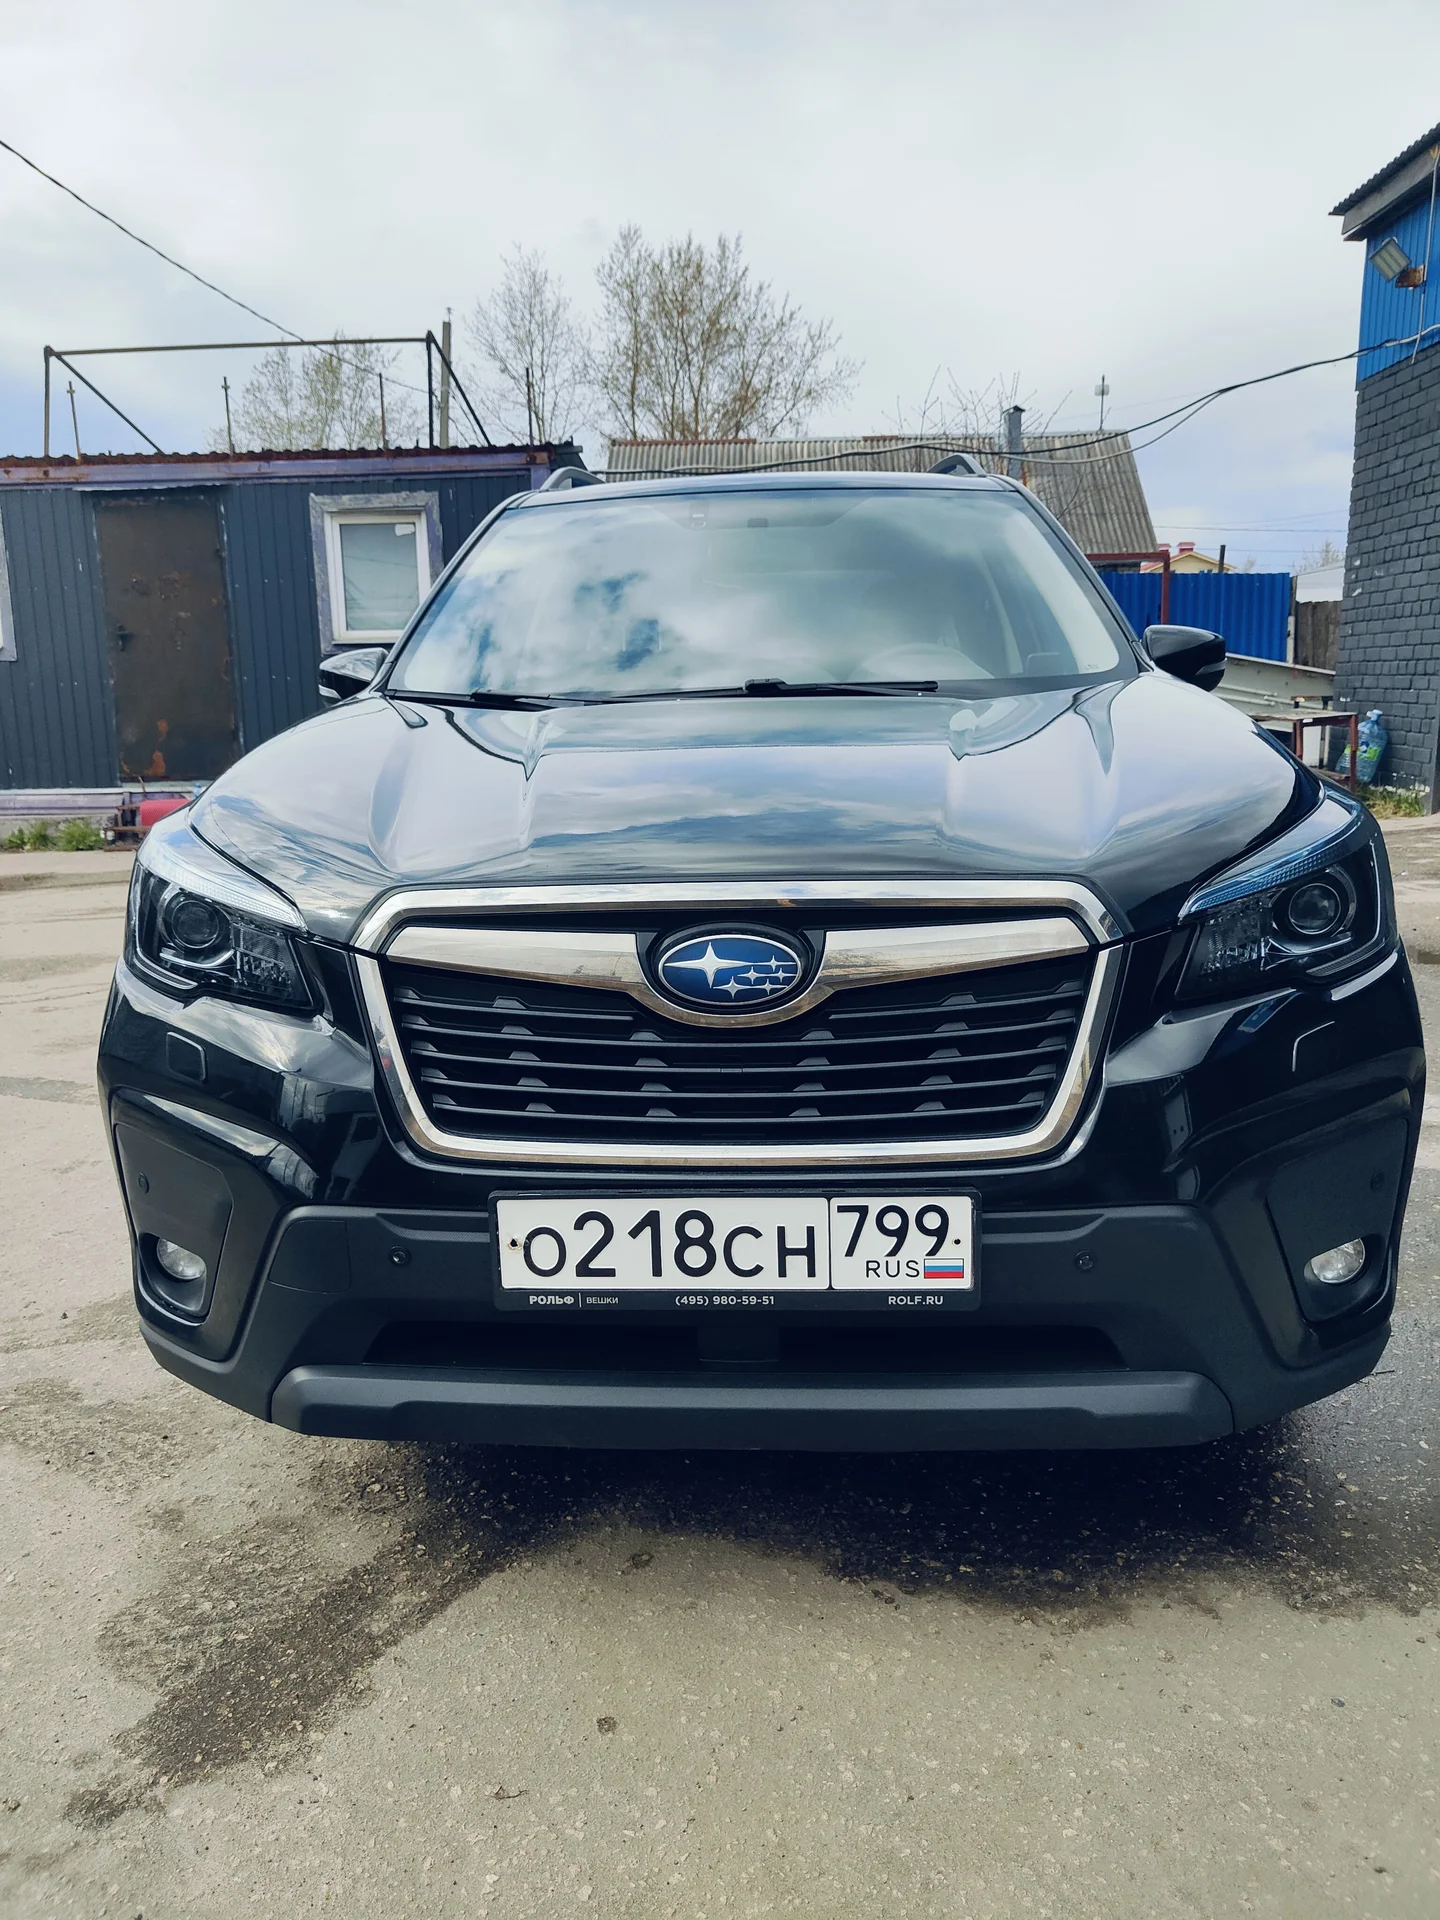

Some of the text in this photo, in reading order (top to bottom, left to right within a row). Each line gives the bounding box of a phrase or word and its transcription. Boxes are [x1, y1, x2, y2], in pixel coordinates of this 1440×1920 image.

[522, 1204, 950, 1278] О218СН 799
[865, 1260, 920, 1279] RUS
[529, 1295, 619, 1305] РОЛЬФ ВЕШКИ
[675, 1295, 775, 1306] (495) 980-59-51
[888, 1296, 944, 1305] ROLF.RU
